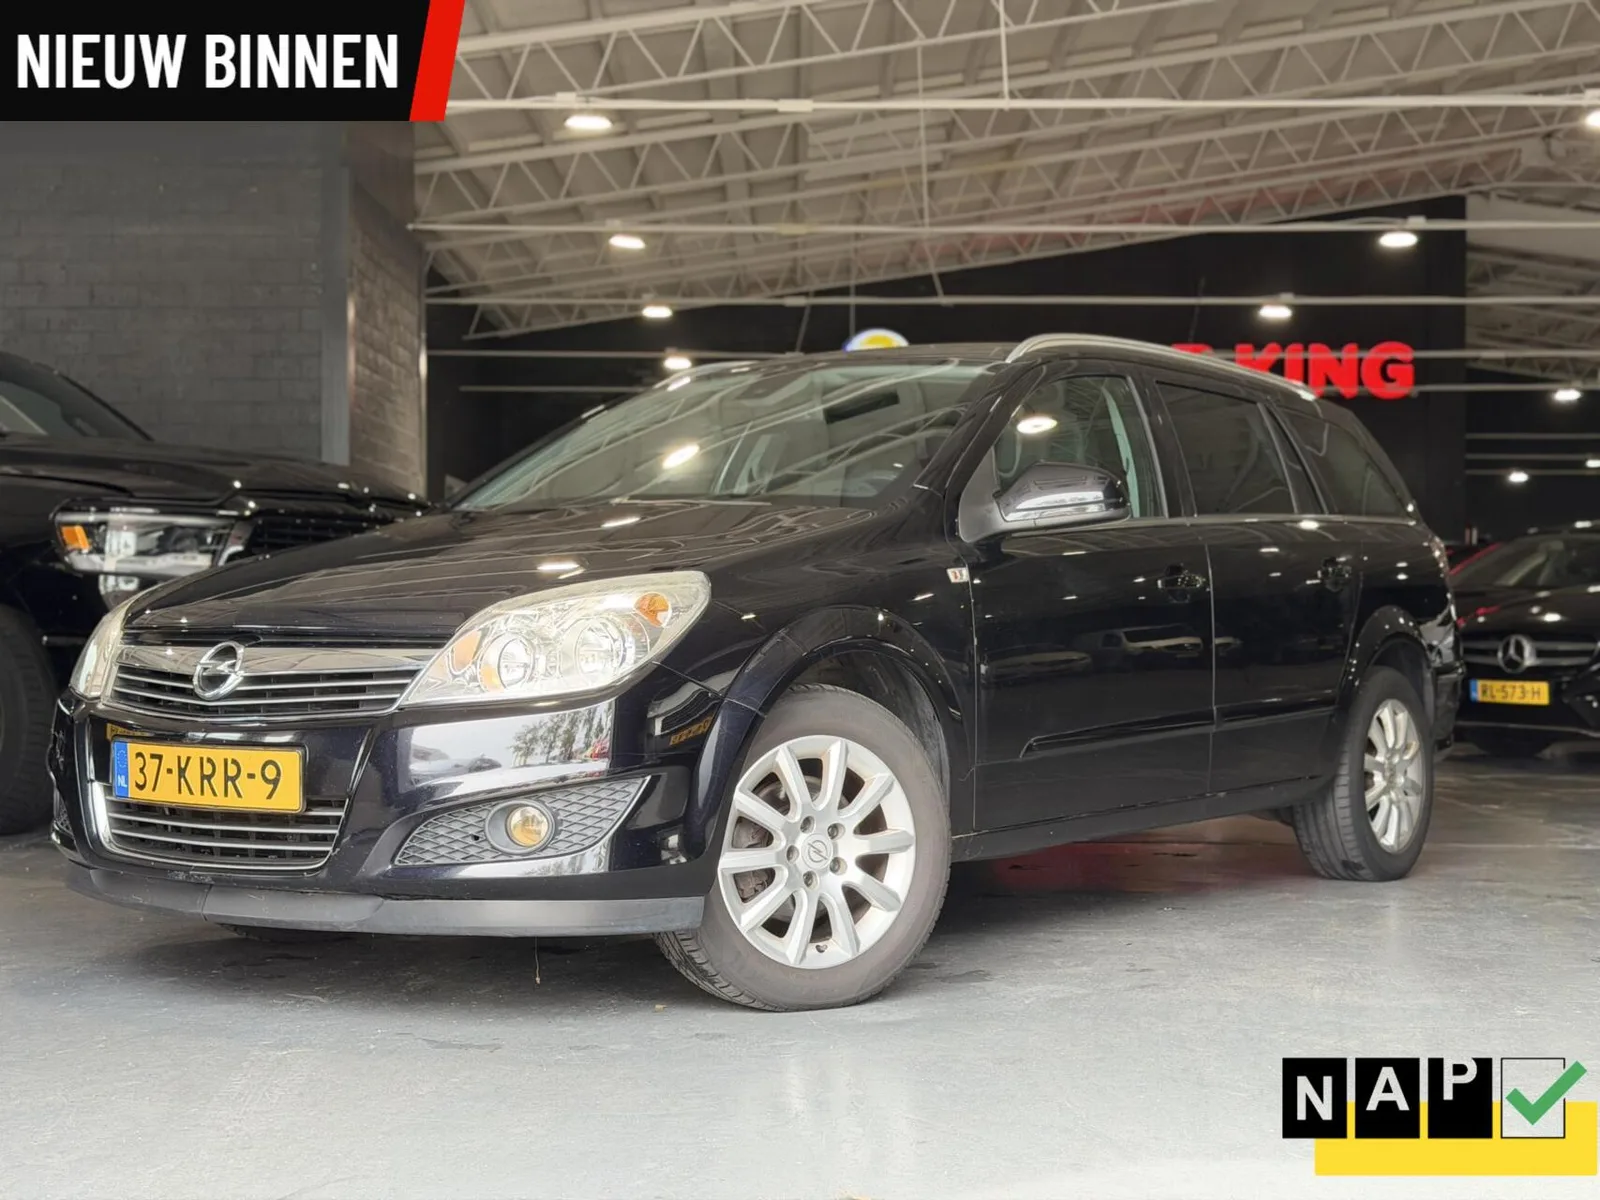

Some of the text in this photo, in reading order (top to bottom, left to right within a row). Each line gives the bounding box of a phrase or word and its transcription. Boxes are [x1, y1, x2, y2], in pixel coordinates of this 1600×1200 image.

[1234, 341, 1414, 400] KING
[117, 773, 128, 788] NL
[134, 751, 282, 800] 37-KRR-9
